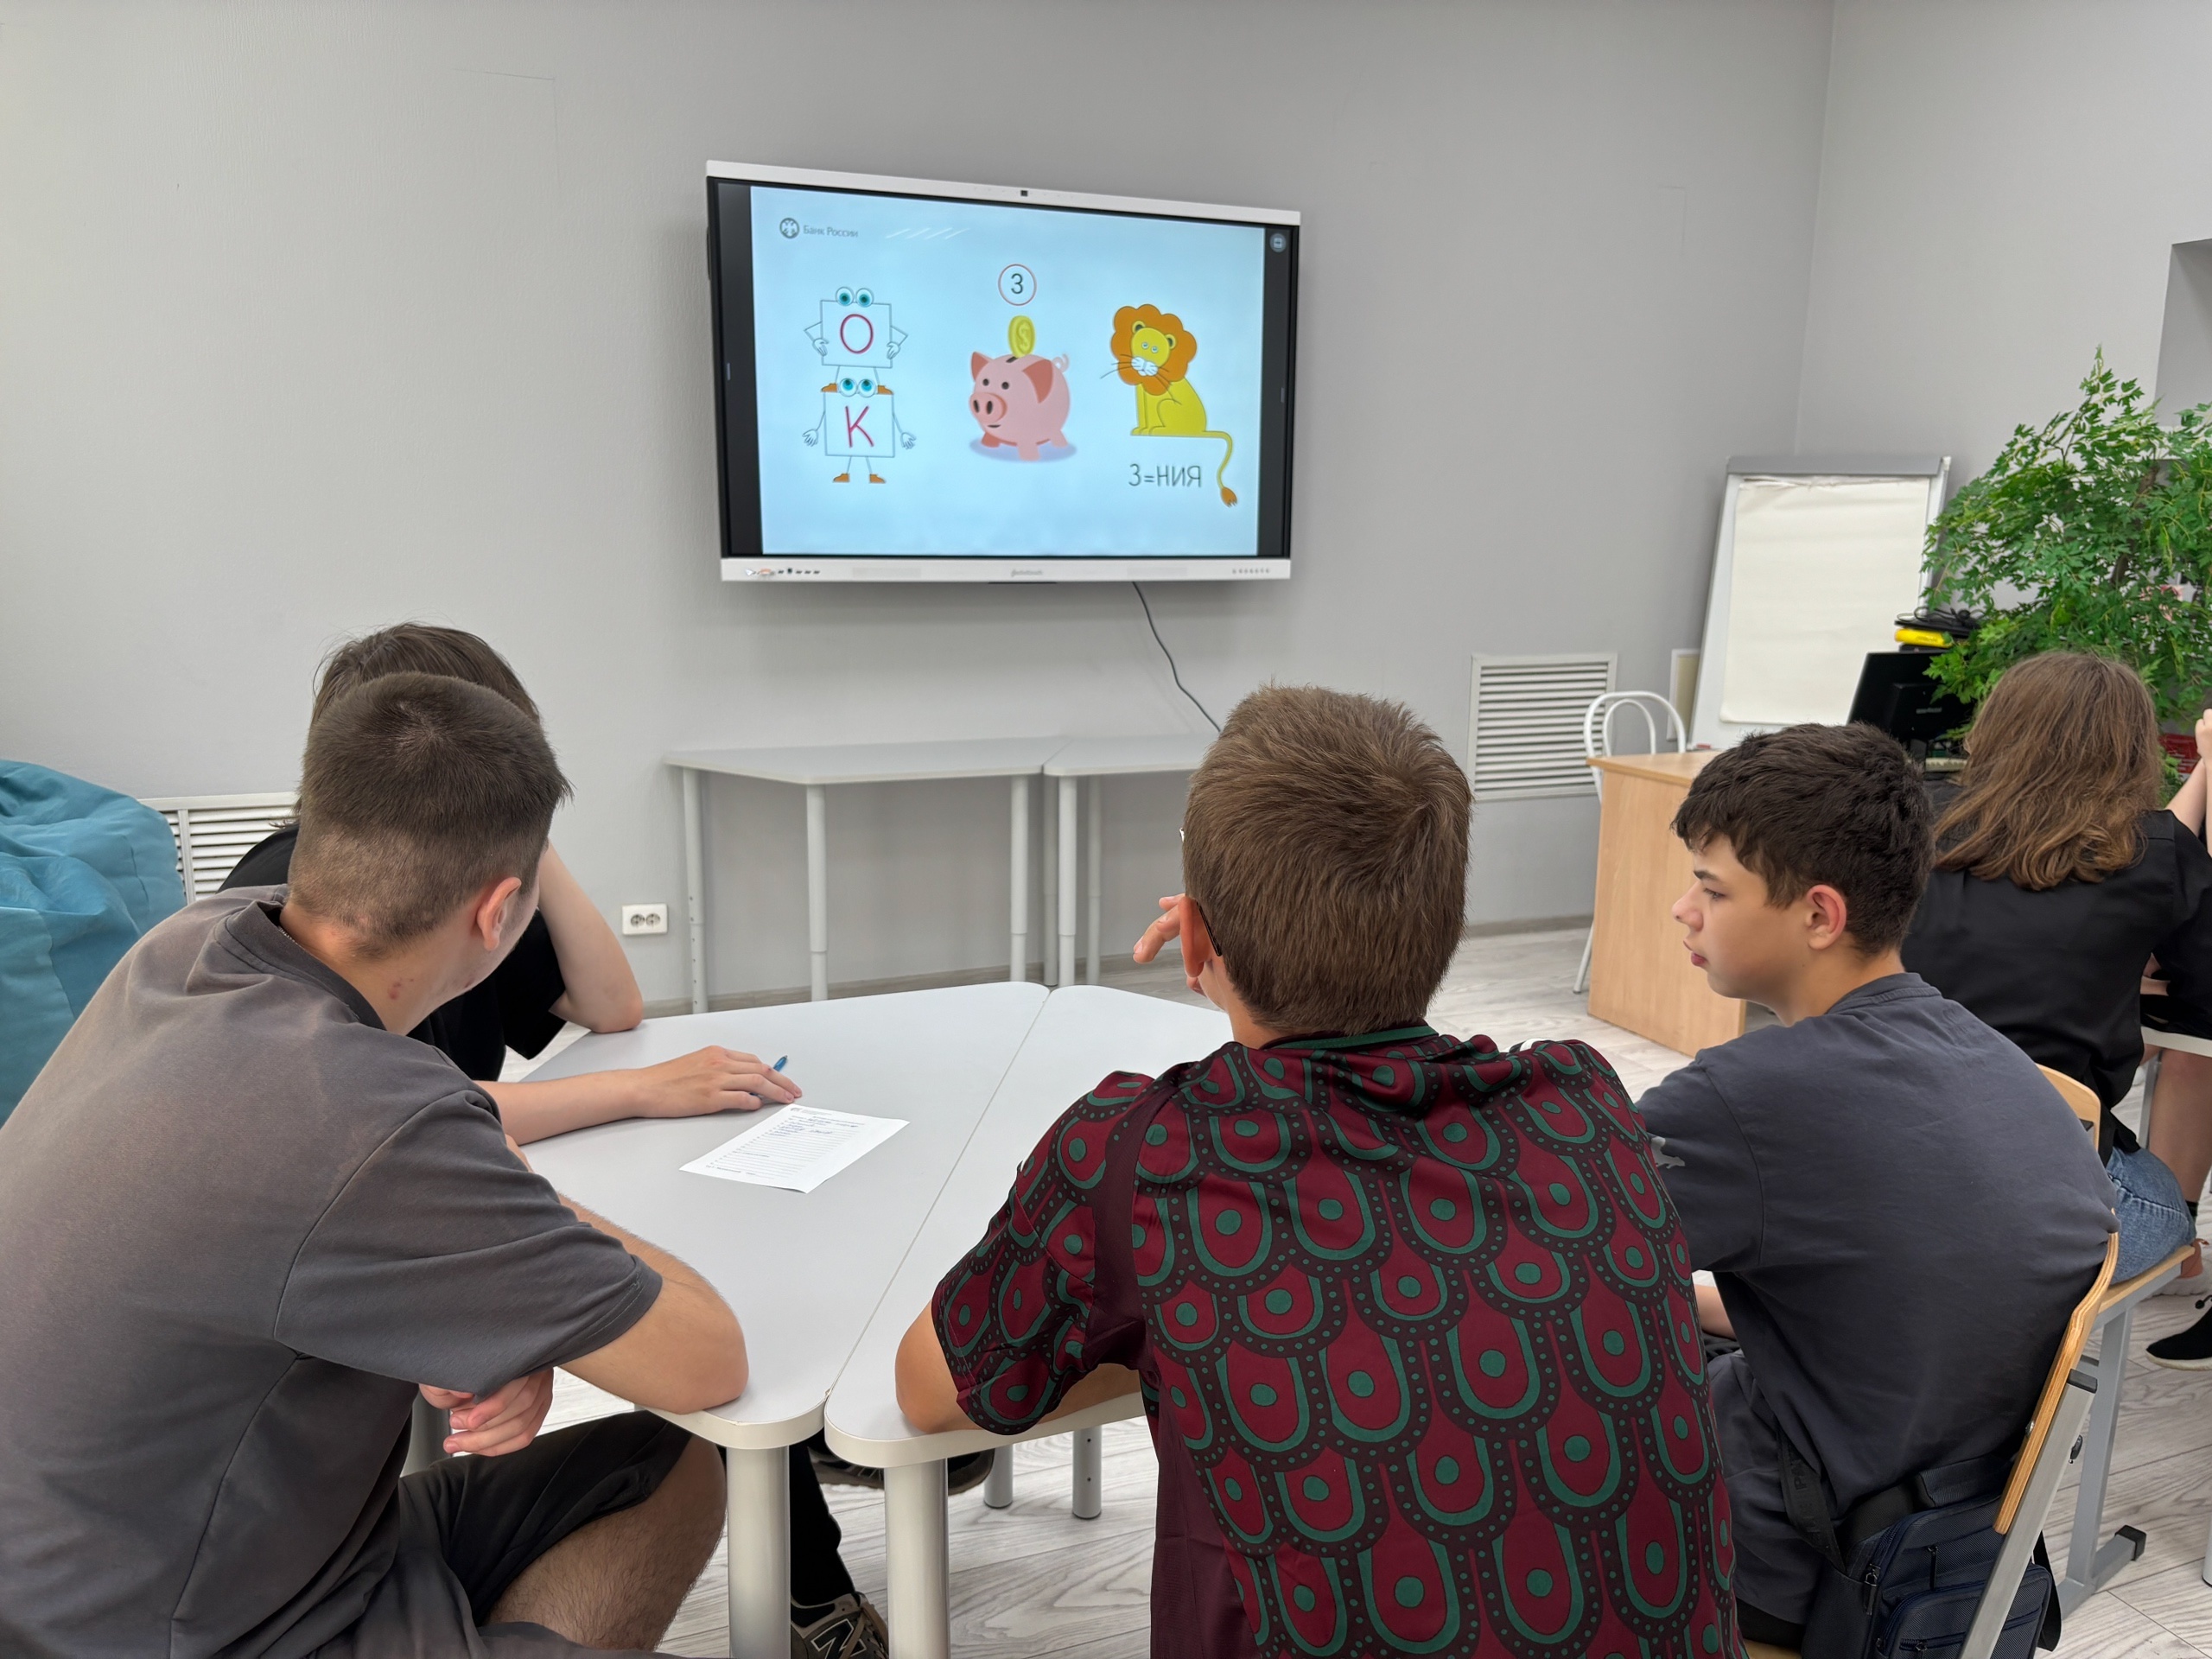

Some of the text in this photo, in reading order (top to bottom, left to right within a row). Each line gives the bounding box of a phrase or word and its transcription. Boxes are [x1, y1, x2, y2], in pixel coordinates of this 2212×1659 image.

[804, 225, 858, 238] Банк России
[1011, 273, 1024, 295] 3
